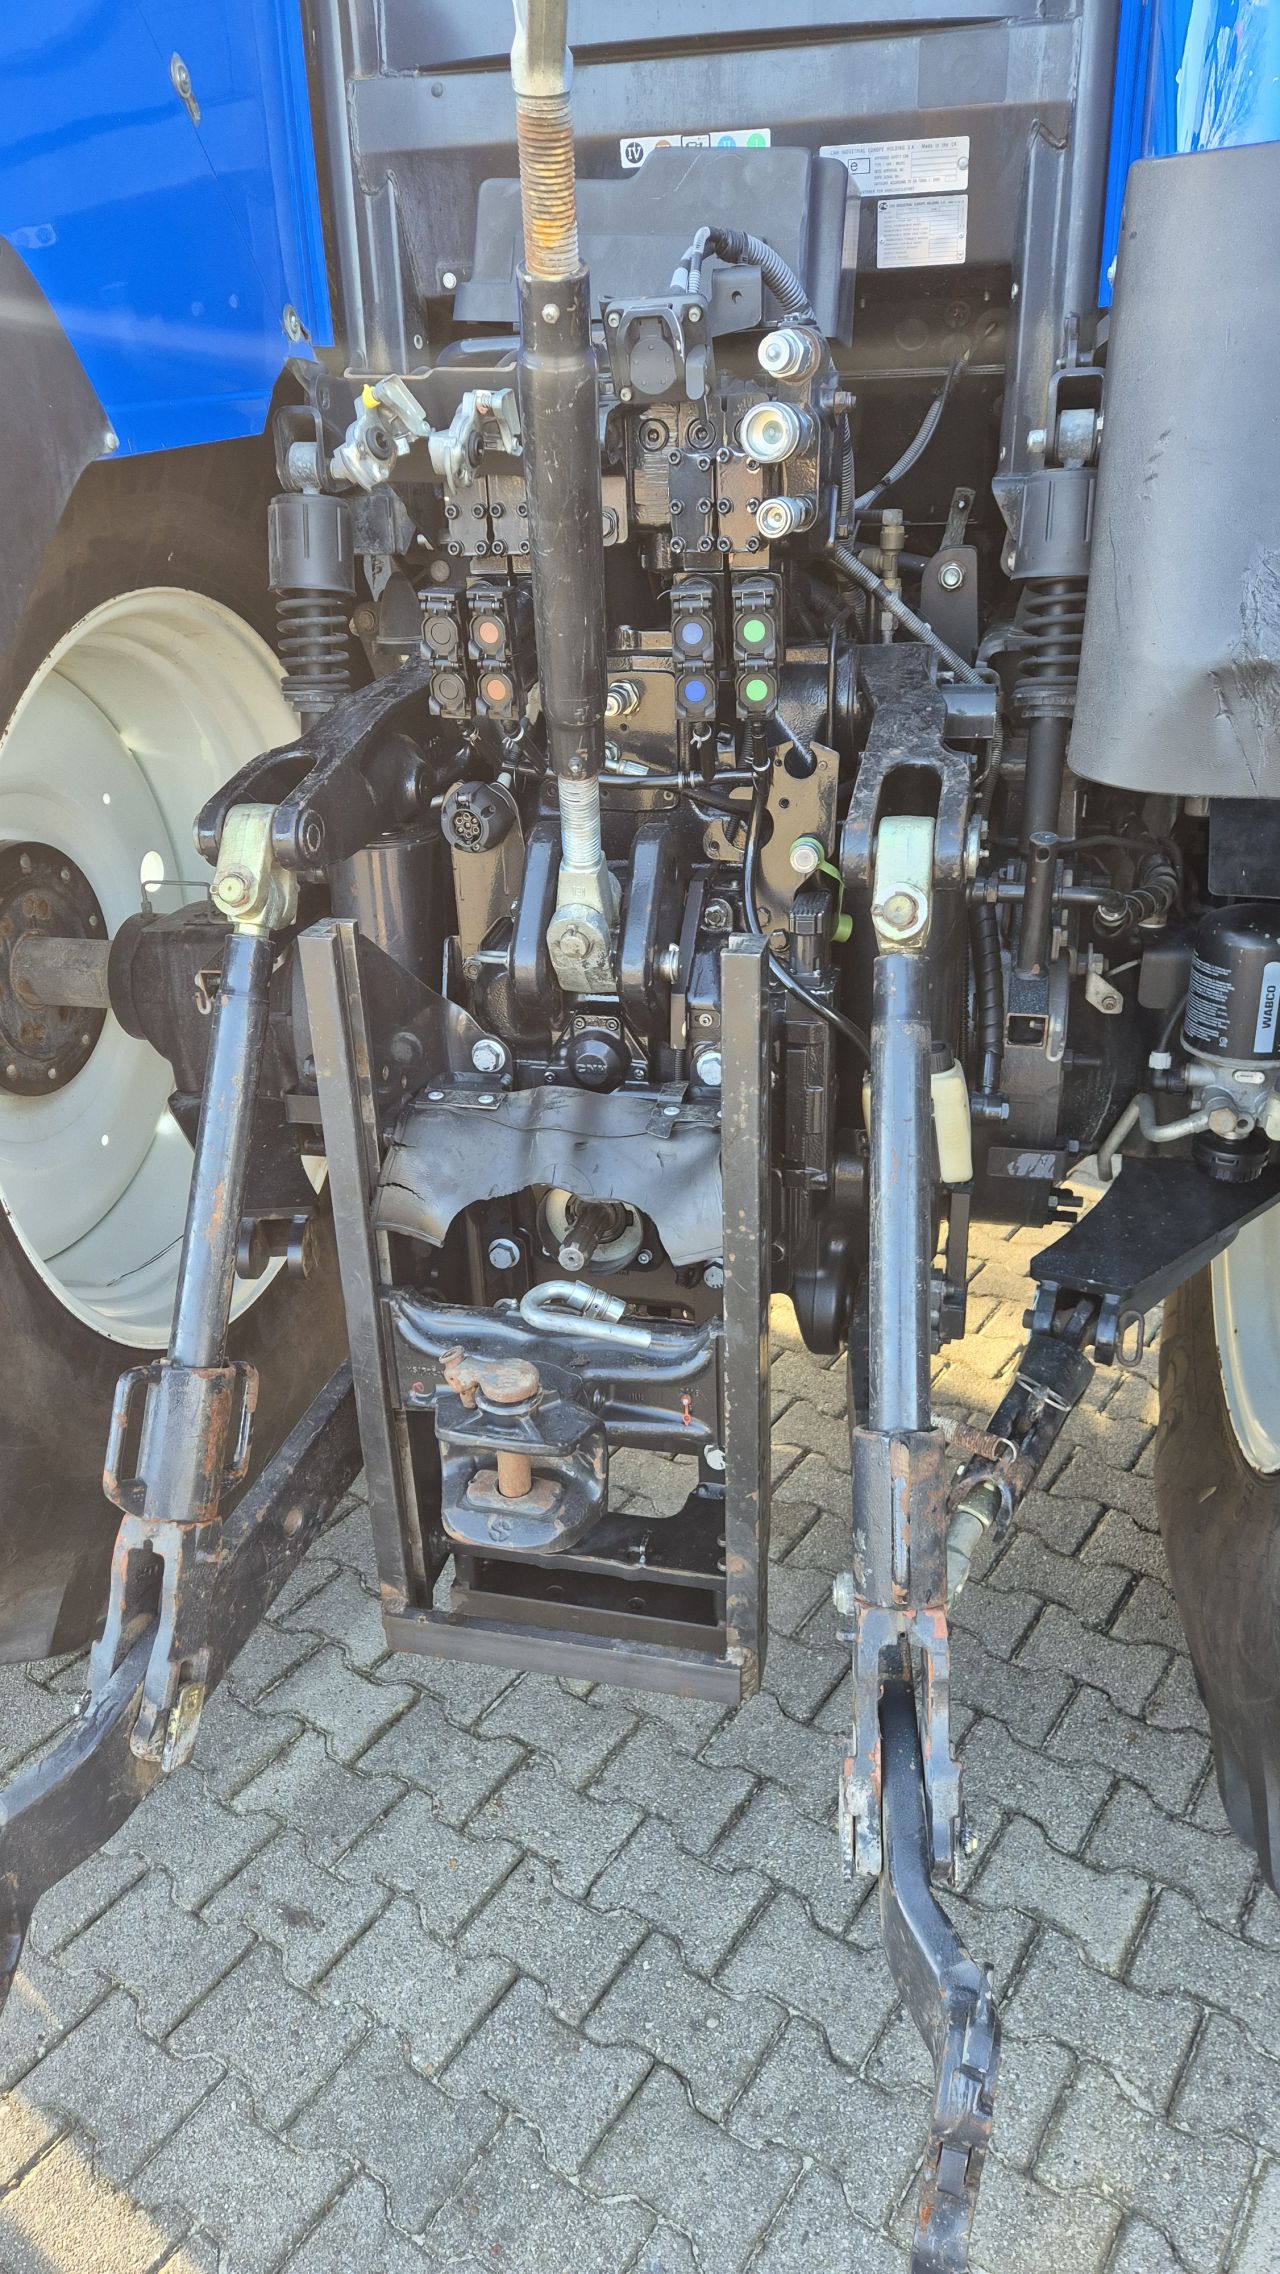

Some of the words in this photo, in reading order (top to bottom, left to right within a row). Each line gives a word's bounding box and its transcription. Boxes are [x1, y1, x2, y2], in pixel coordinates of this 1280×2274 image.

[627, 147, 642, 161] IV
[850, 161, 858, 171] e
[1262, 985, 1276, 1029] WABCO
